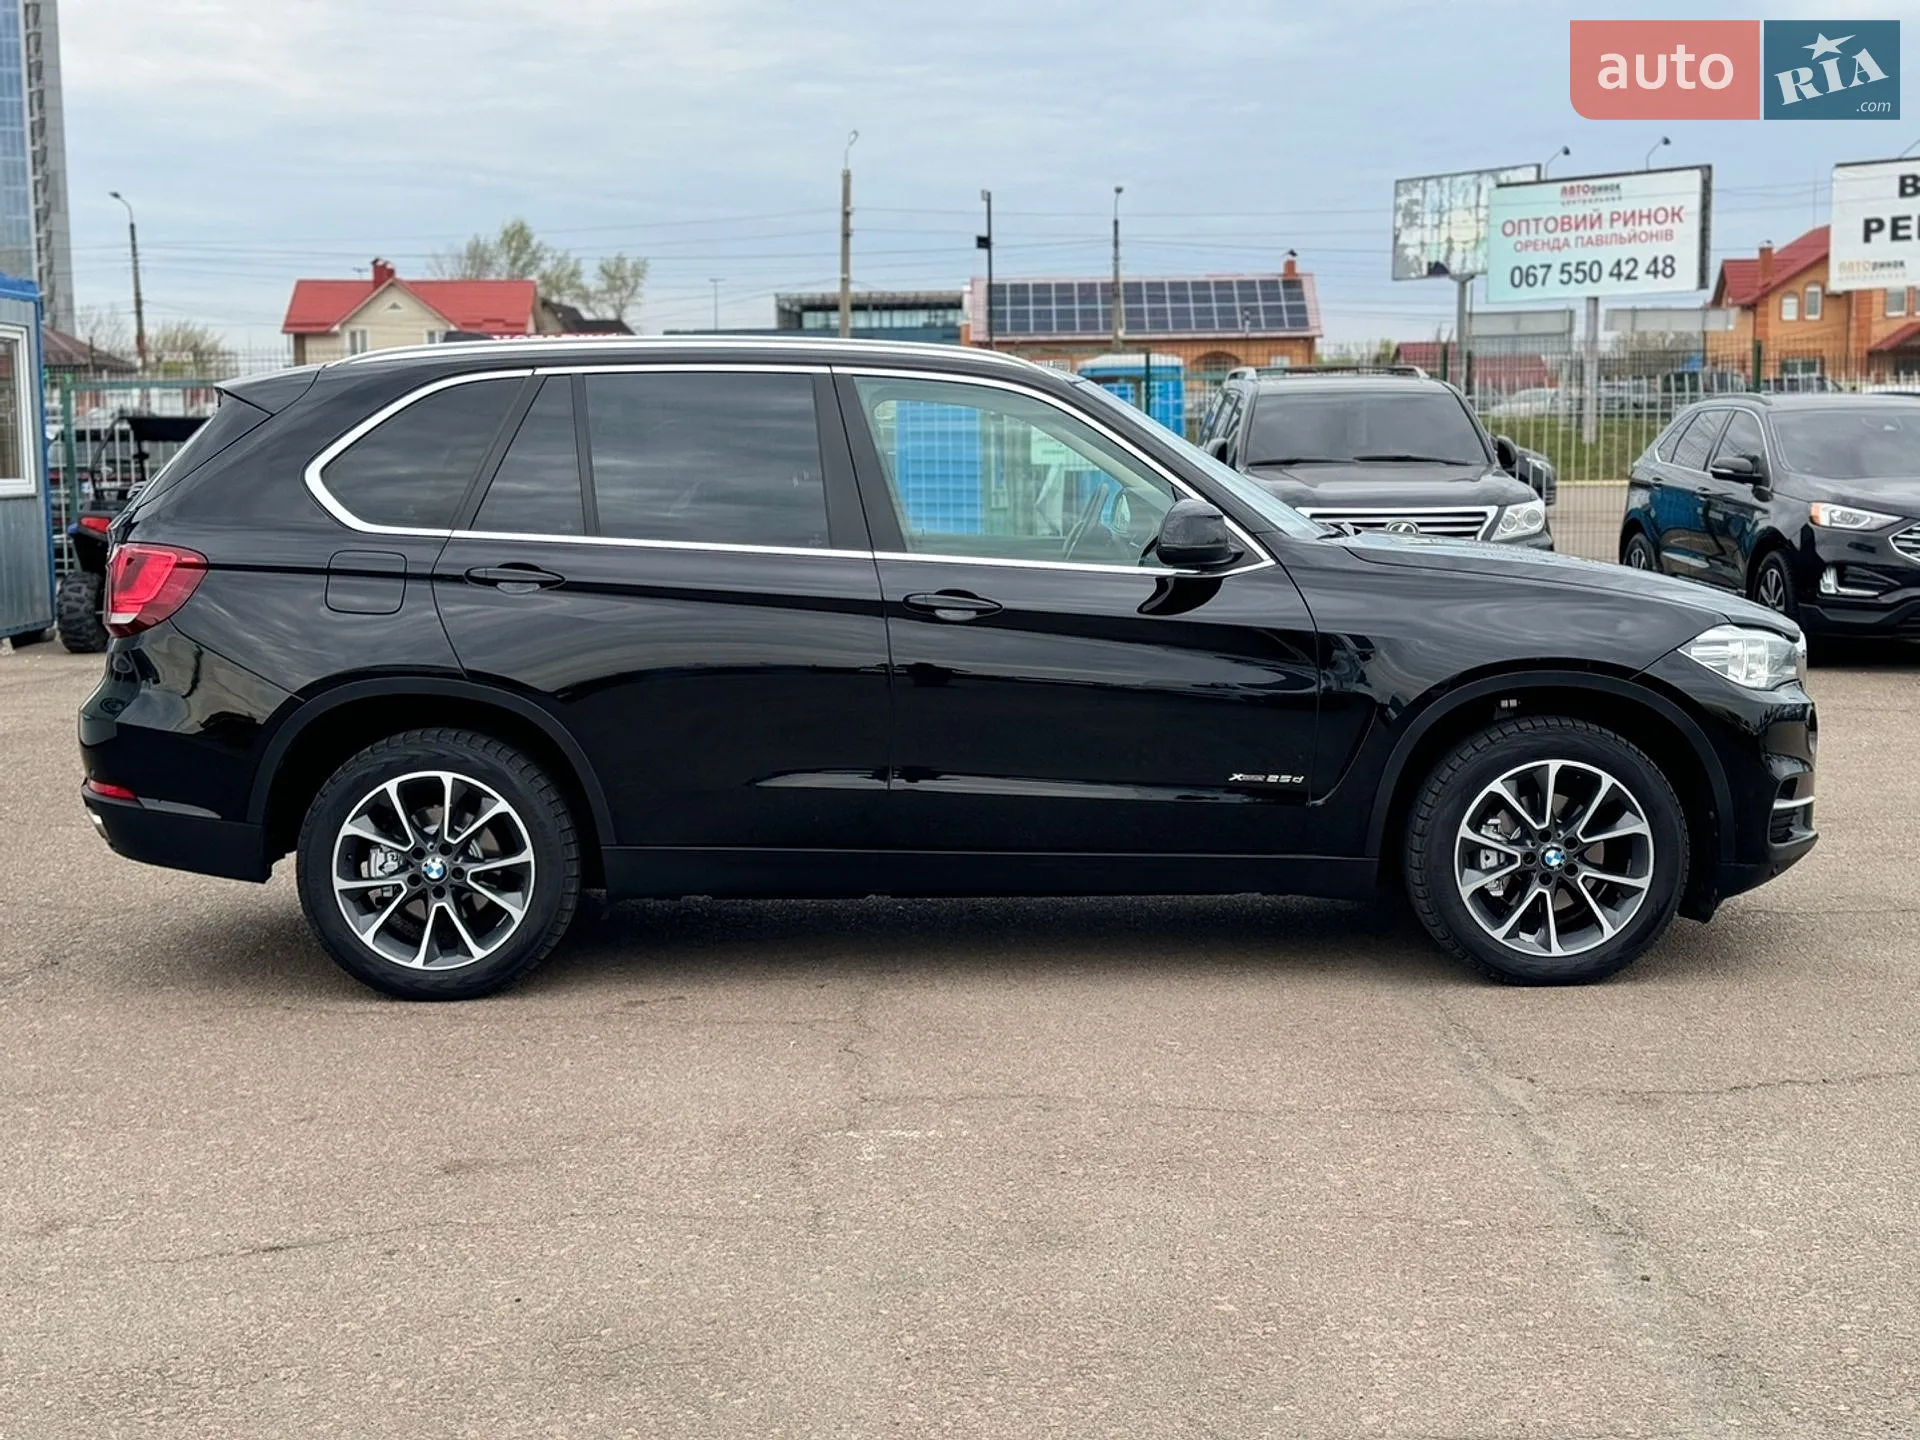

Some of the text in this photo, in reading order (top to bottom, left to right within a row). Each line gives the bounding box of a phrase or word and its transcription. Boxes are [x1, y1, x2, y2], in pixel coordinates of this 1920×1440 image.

[1501, 205, 1685, 237] ОПТОВИЙ РИНОК
[1863, 215, 1920, 243] РЕ
[1513, 228, 1675, 254] ОРЕНДА ПАВІЛЬЙОНІВ
[1509, 255, 1676, 289] 067 550 42 48
